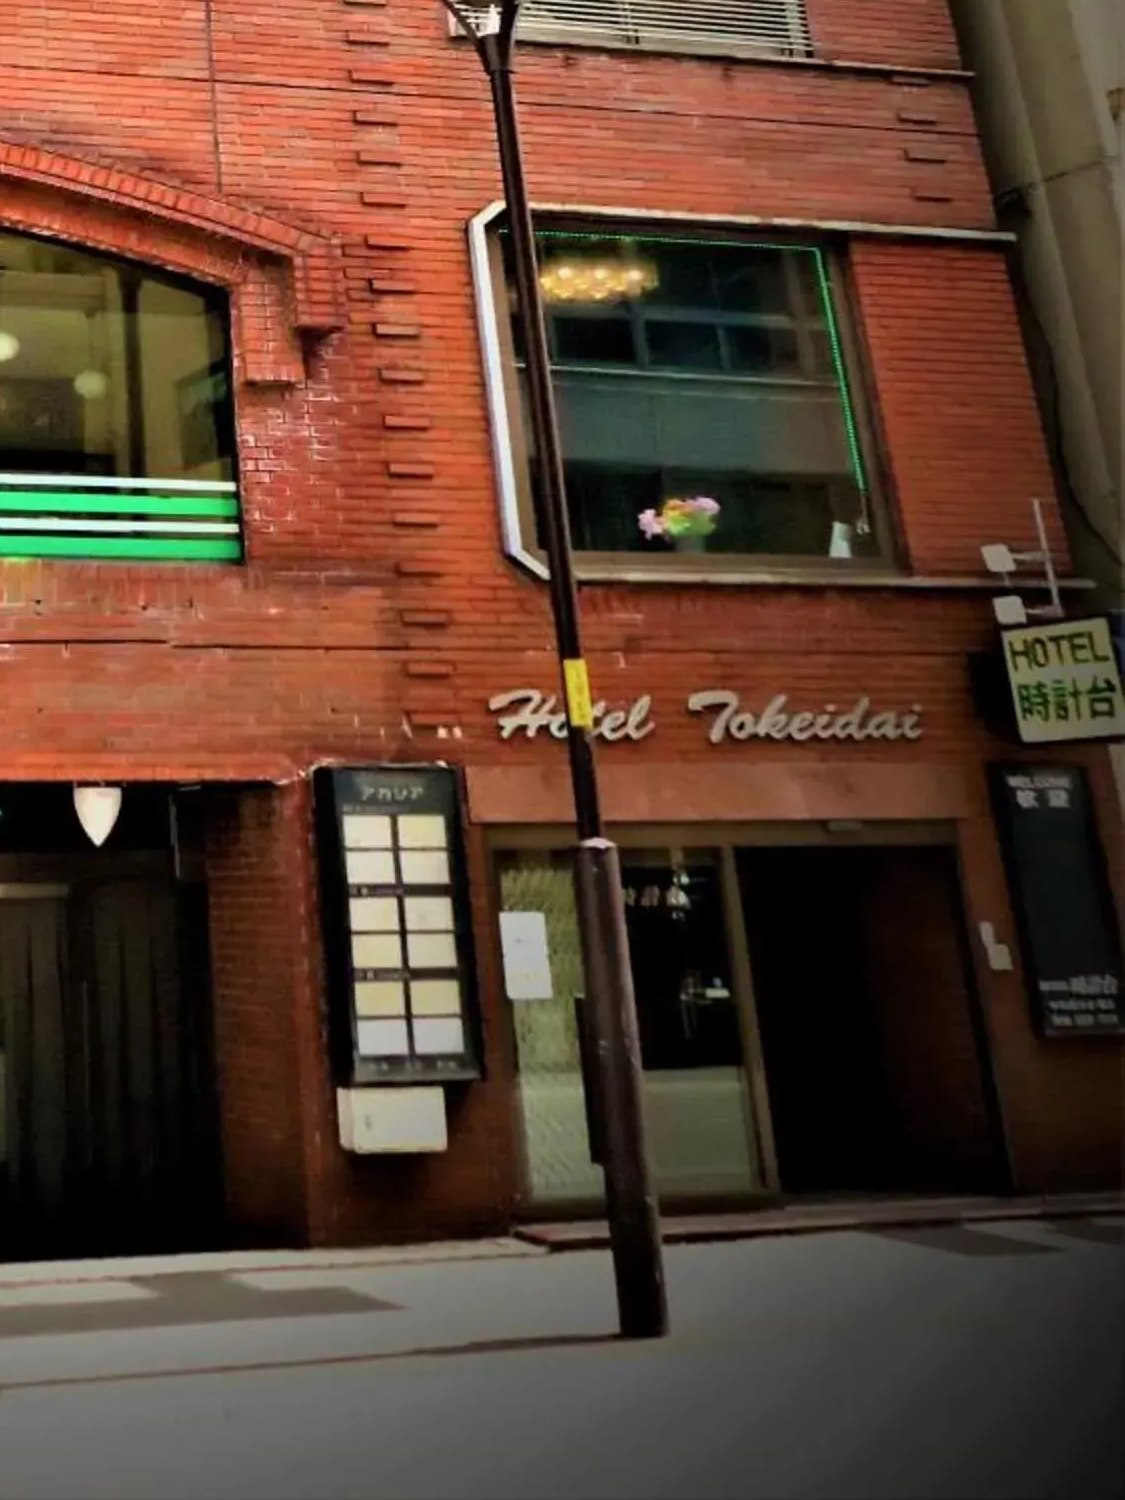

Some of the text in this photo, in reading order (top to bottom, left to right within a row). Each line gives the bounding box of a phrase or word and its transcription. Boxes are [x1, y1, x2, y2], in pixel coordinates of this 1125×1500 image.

[1008, 631, 1111, 672] HOTEL
[688, 690, 923, 743] Tokeidai
[1017, 676, 1117, 722] 時計台
